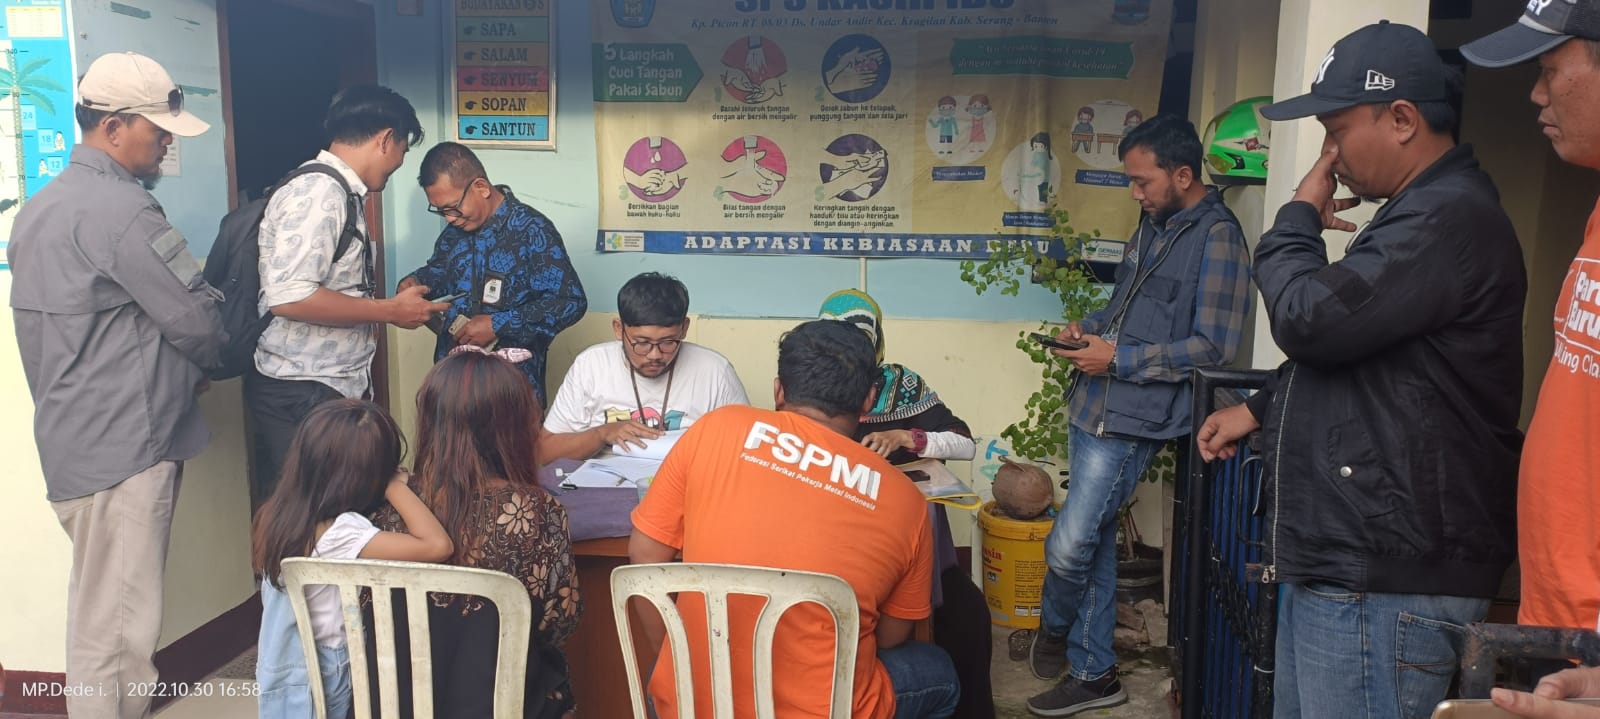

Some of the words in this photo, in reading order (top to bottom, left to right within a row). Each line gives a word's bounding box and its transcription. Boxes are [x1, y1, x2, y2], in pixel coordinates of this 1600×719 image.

[877, 14, 897, 26] Kec.
[900, 14, 947, 27] Kragilan
[949, 13, 973, 26] Kab.
[976, 13, 1015, 27] Serang
[480, 22, 517, 37] SAPA
[481, 47, 528, 62] SALAM
[604, 42, 617, 61] 5
[619, 48, 675, 65] Langkah
[481, 72, 539, 86] SENYUM
[608, 66, 634, 79] Cuci
[636, 66, 683, 82] Tangan
[608, 83, 642, 97] Pakai
[644, 83, 683, 97] Sabun
[481, 97, 528, 112] SOPAN
[766, 105, 790, 115] tangan
[840, 104, 859, 112] sabun
[23, 112, 33, 120] 24
[712, 114, 735, 122] dengan
[748, 113, 768, 121] bersih
[769, 113, 798, 122] mengalir
[810, 113, 842, 122] punggung
[843, 113, 866, 121] tangan
[867, 113, 880, 121] dan
[895, 112, 908, 121] jari
[481, 122, 537, 137] SANTUN
[41, 135, 51, 143] 18
[51, 160, 60, 169] 12
[618, 185, 629, 200] 3
[658, 203, 680, 213] bagian
[722, 203, 738, 211] Bilas
[738, 204, 762, 214] tangan
[762, 204, 787, 214] dengan
[813, 204, 846, 214] Keringkan
[847, 205, 870, 214] tangan
[871, 205, 896, 214] dengan
[734, 211, 755, 219] bersih
[756, 211, 785, 221] mengalir
[866, 212, 900, 222] keringkan
[813, 220, 836, 229] dengan
[684, 235, 812, 251] ADAPTASI
[823, 236, 974, 254] KEBIASAAN
[743, 420, 882, 502] FSPMI
[739, 451, 771, 469] Federasi
[769, 462, 797, 480] Serikat
[795, 473, 824, 490] Pekerja
[823, 483, 845, 497] Metal
[842, 491, 877, 512] Indonesia
